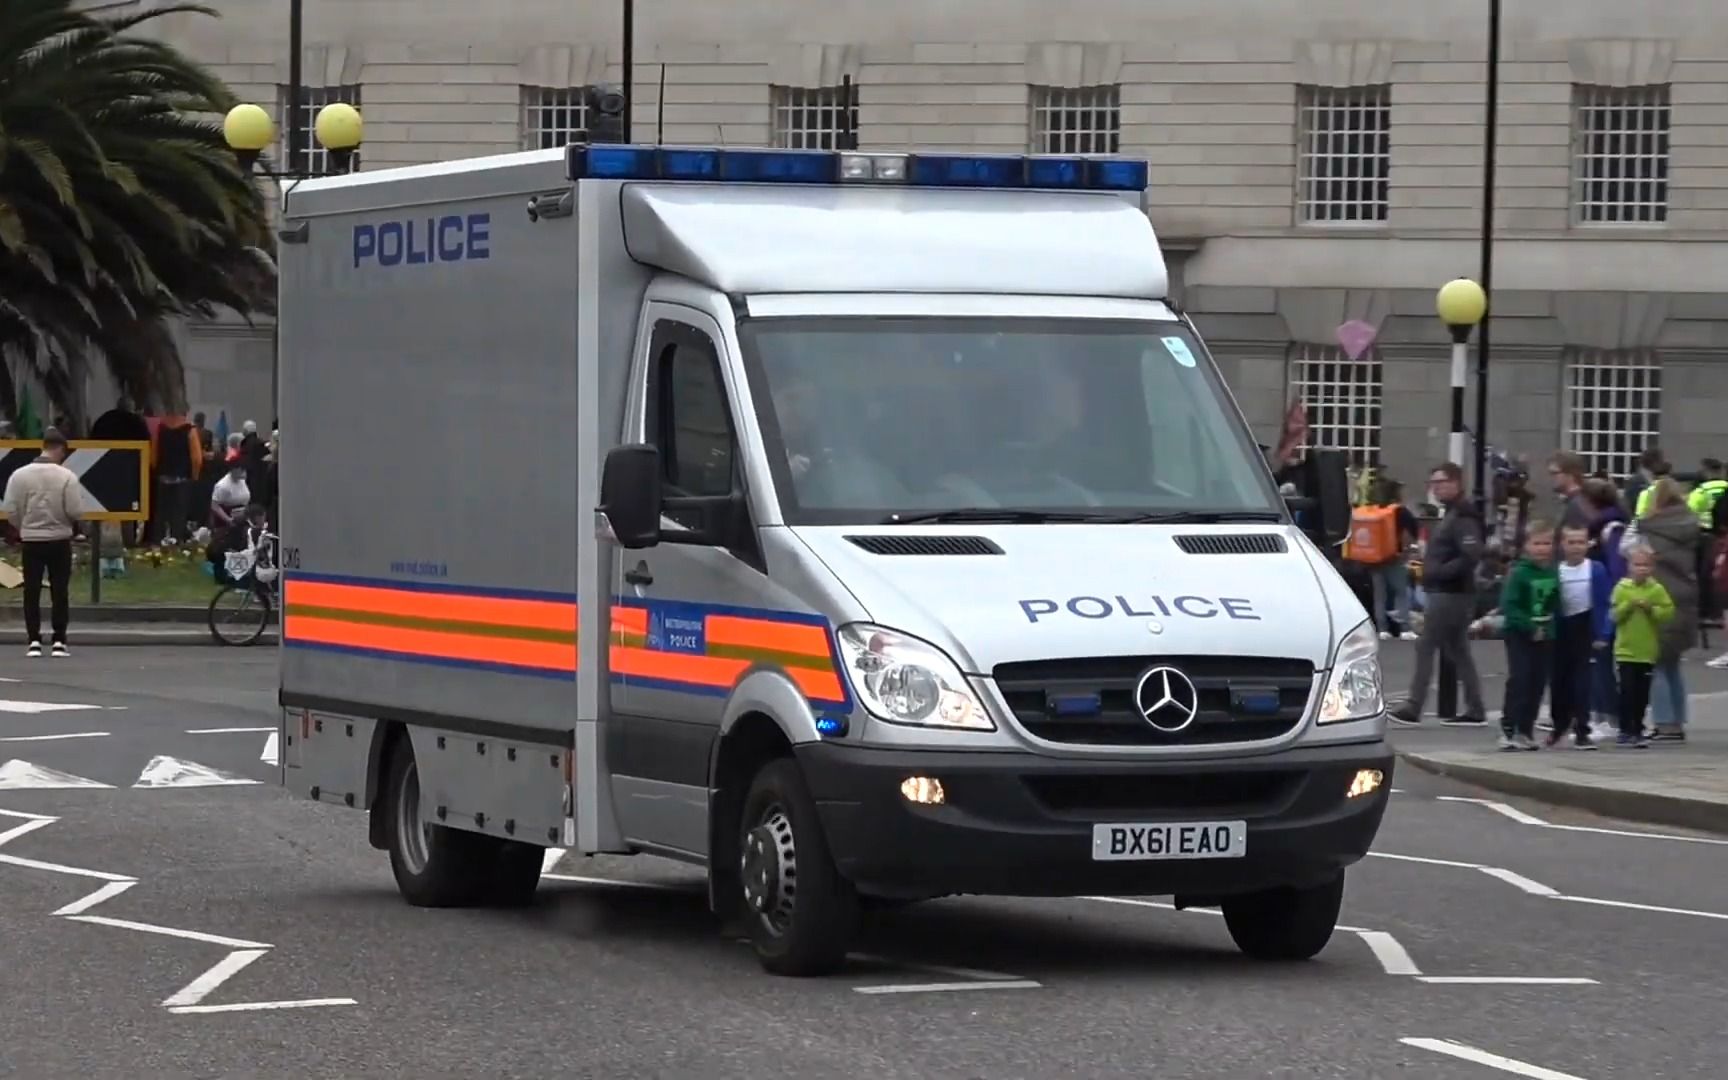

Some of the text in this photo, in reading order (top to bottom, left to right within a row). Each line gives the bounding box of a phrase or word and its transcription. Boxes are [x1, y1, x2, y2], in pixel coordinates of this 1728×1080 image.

[353, 213, 490, 269] POLICE
[1018, 595, 1261, 623] POLICE
[670, 634, 696, 649] POLICE
[1110, 826, 1230, 854] BX61 EAO
